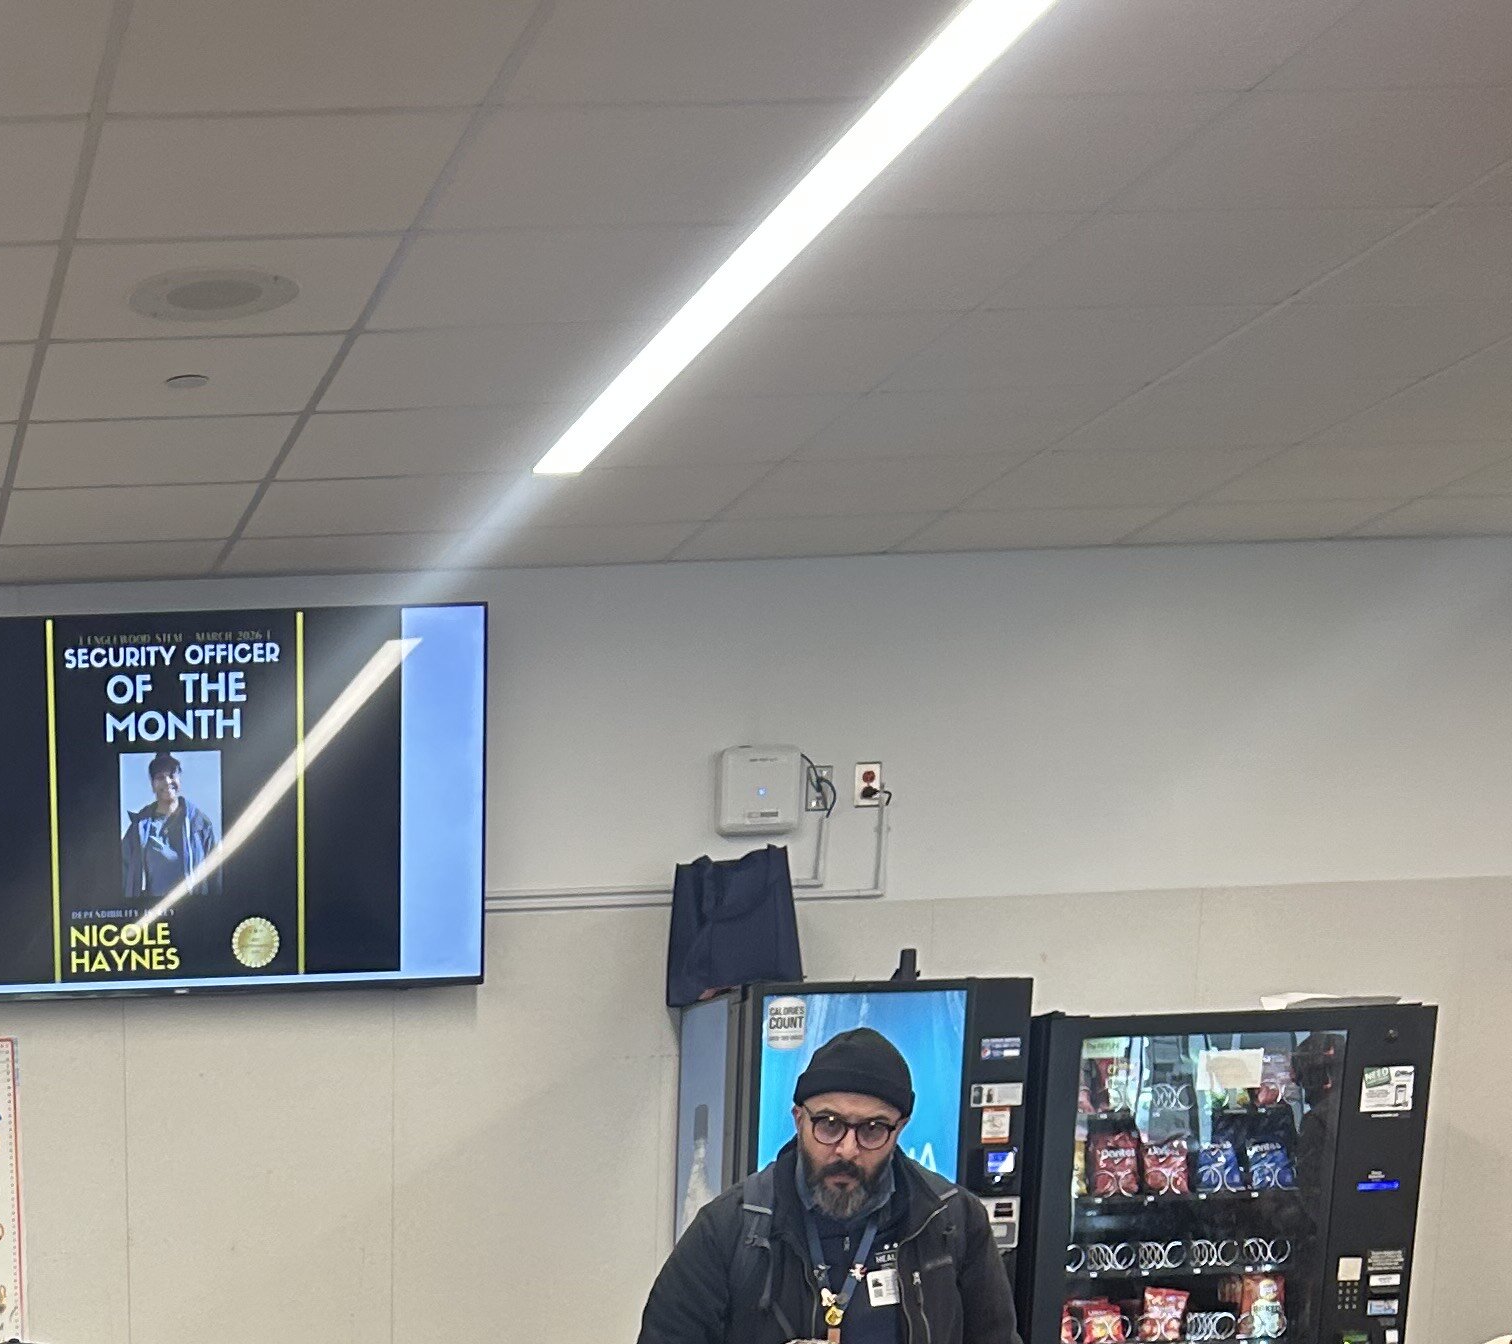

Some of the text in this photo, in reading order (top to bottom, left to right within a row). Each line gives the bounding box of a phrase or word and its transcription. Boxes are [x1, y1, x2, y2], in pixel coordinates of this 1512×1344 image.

[64, 643, 280, 669] SECURITY OFFICER
[107, 672, 247, 704] OF THE
[106, 709, 241, 742] MONTH
[70, 923, 170, 947] NICOLE
[71, 948, 180, 973] HAYNES
[769, 1005, 805, 1017] CALORIES
[769, 1016, 804, 1030] COUNT
